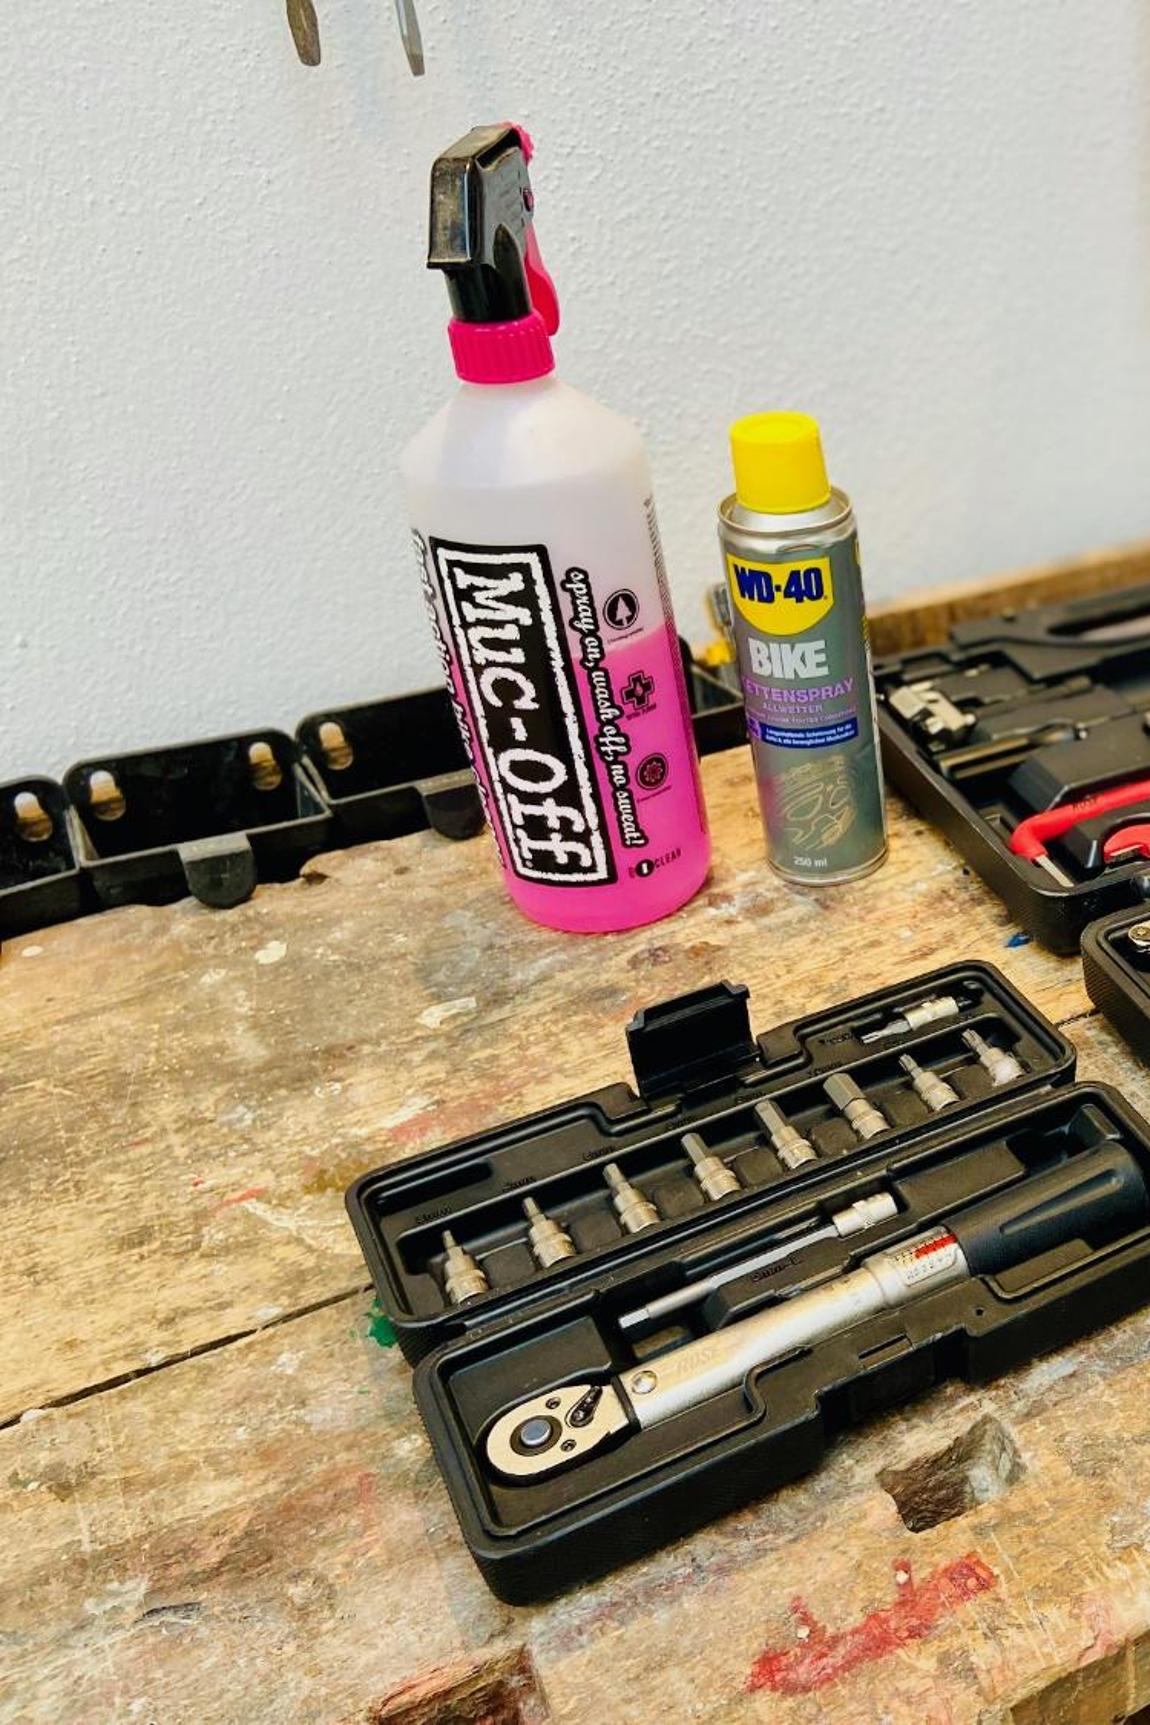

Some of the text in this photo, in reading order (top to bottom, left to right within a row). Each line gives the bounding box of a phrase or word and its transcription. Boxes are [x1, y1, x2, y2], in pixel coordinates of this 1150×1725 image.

[733, 564, 824, 603] WD-40
[747, 636, 830, 680] BIKE
[565, 570, 645, 846] spray on, wash off, no sweat!
[741, 675, 853, 703] ETTENSPRAY
[453, 567, 592, 868] Muc-Off
